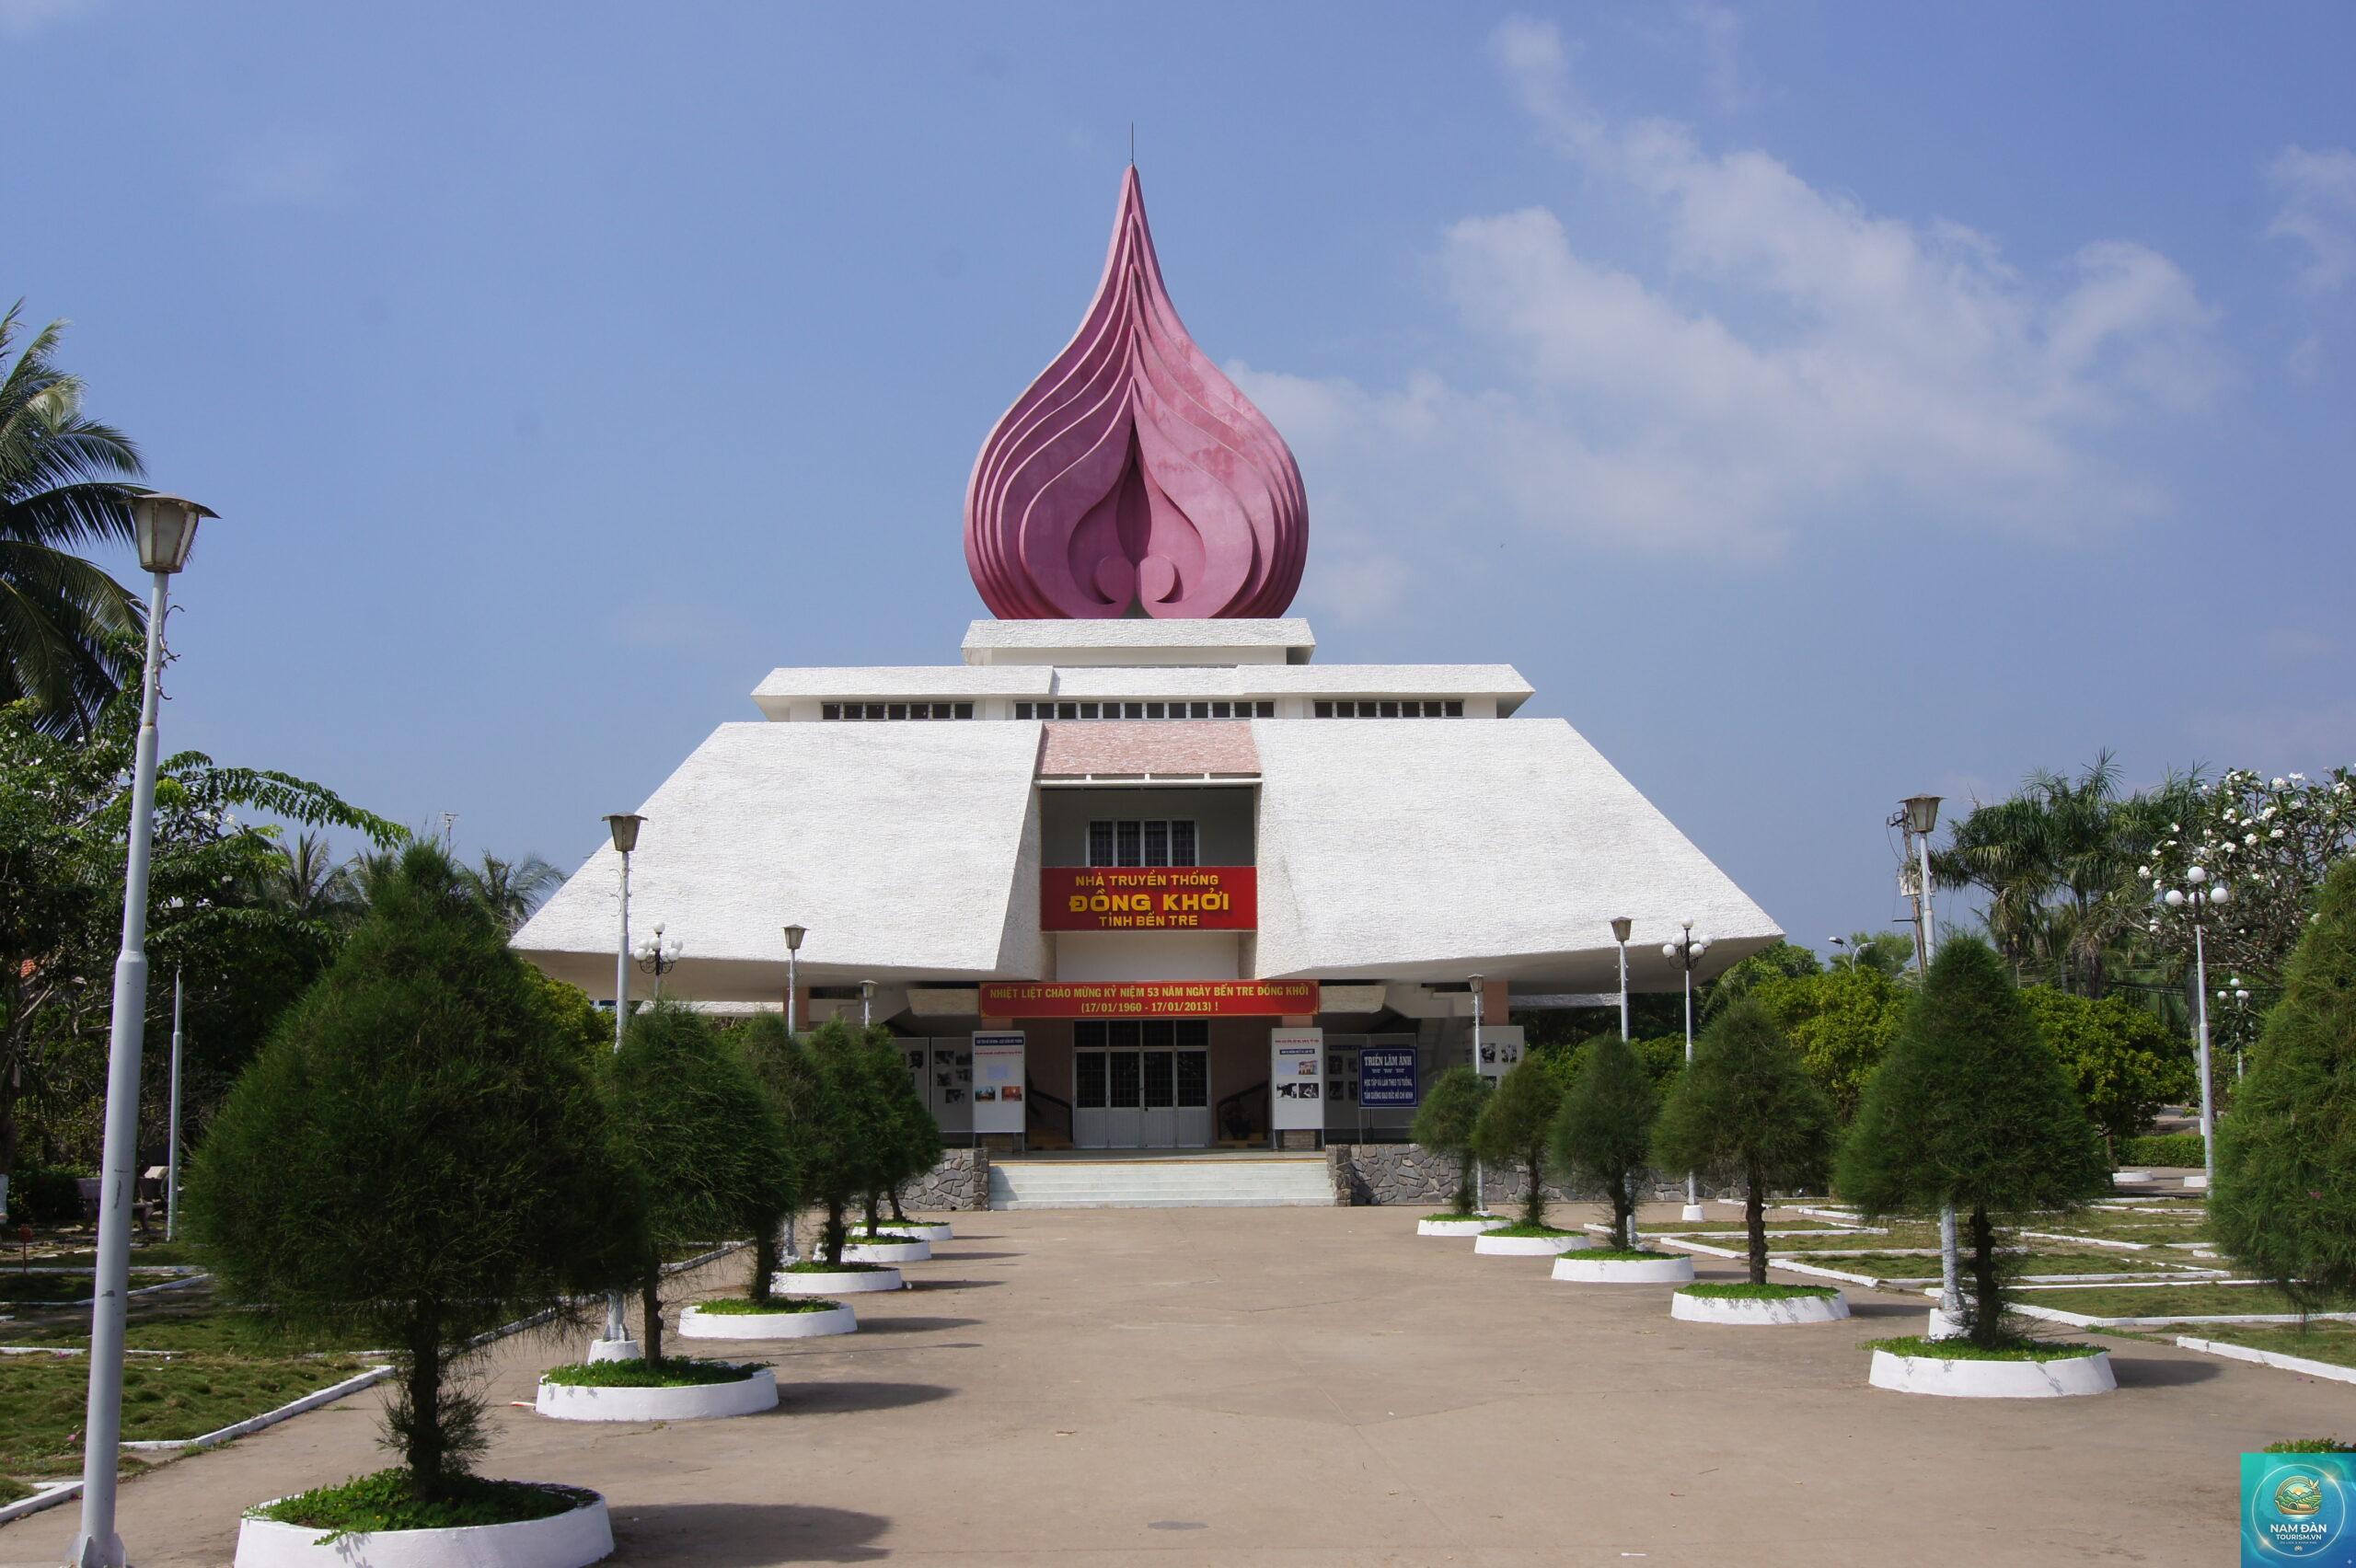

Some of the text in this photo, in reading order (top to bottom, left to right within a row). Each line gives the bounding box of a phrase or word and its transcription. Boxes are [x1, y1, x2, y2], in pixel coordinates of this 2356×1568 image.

[1076, 872, 1104, 886] NHÀ
[1171, 870, 1218, 885] THỐNG
[1068, 888, 1230, 912] ĐỒNG KHỞI
[1136, 910, 1165, 926] BẾN
[1169, 916, 1197, 926] TRE
[990, 986, 1018, 1000] NHIỆT
[1022, 986, 1043, 1000] LIỆT
[1045, 986, 1070, 998] CHÀO
[1120, 985, 1145, 1000] NIỆM
[1148, 987, 1160, 997] 53
[1162, 986, 1183, 997] NĂM
[1186, 985, 1210, 997] NGÀY
[1215, 984, 1233, 997] BẾN
[1236, 986, 1254, 996] TRE
